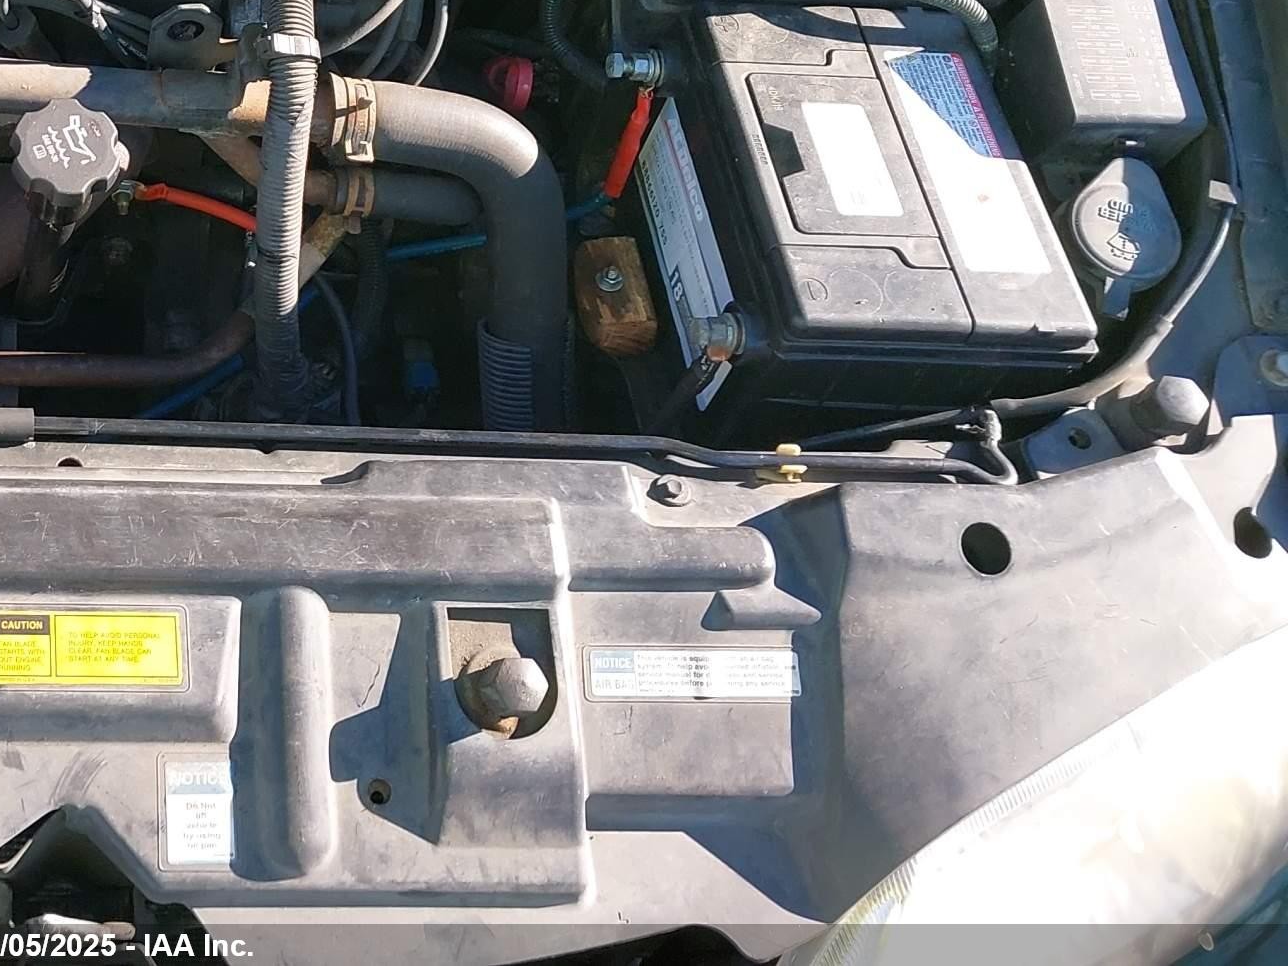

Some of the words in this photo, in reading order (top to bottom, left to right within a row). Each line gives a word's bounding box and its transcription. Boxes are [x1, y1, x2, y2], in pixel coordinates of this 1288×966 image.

[669, 271, 684, 301] 18
[0, 620, 44, 630] CAUTION
[593, 656, 633, 668] NOTICE
[594, 678, 612, 690] AIR
